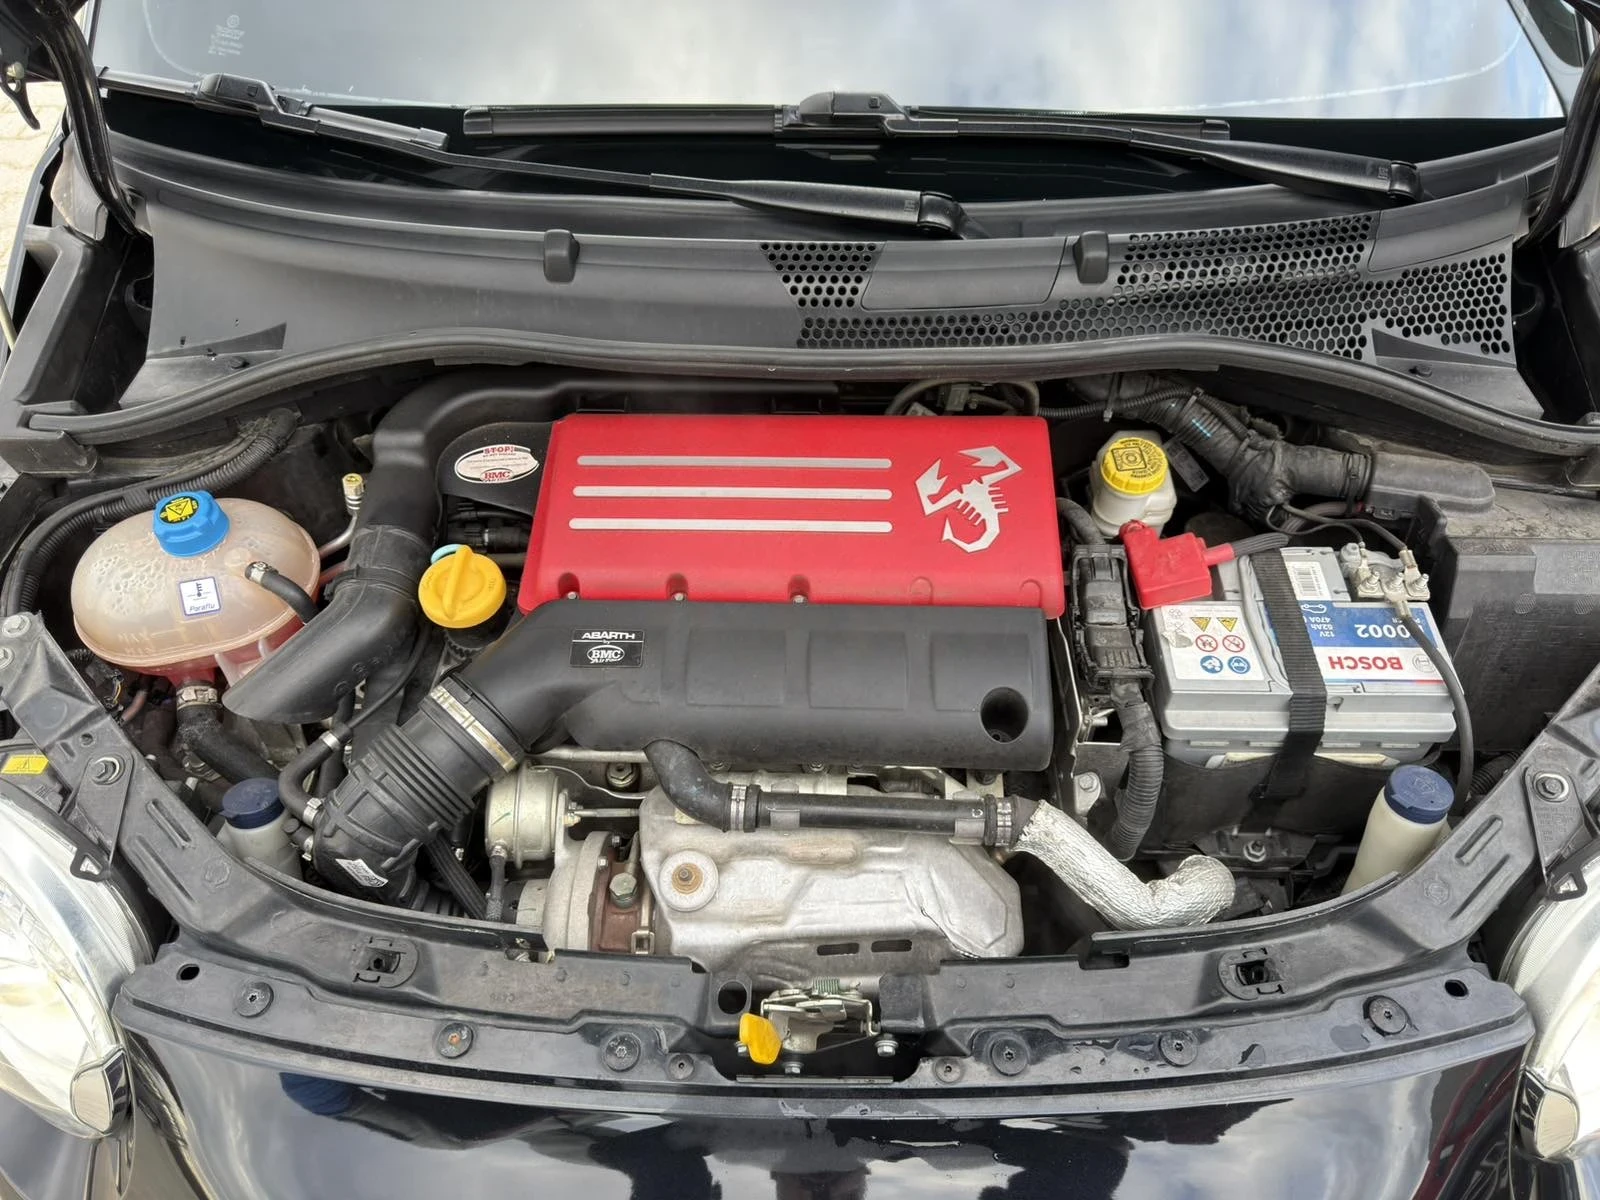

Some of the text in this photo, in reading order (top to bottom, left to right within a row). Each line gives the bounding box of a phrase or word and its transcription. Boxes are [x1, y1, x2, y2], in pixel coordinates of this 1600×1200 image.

[485, 471, 510, 479] BMC
[582, 631, 636, 640] ABARTH
[1354, 624, 1424, 638] 0002
[591, 649, 621, 659] BMC
[1328, 656, 1403, 671] BOSCH
